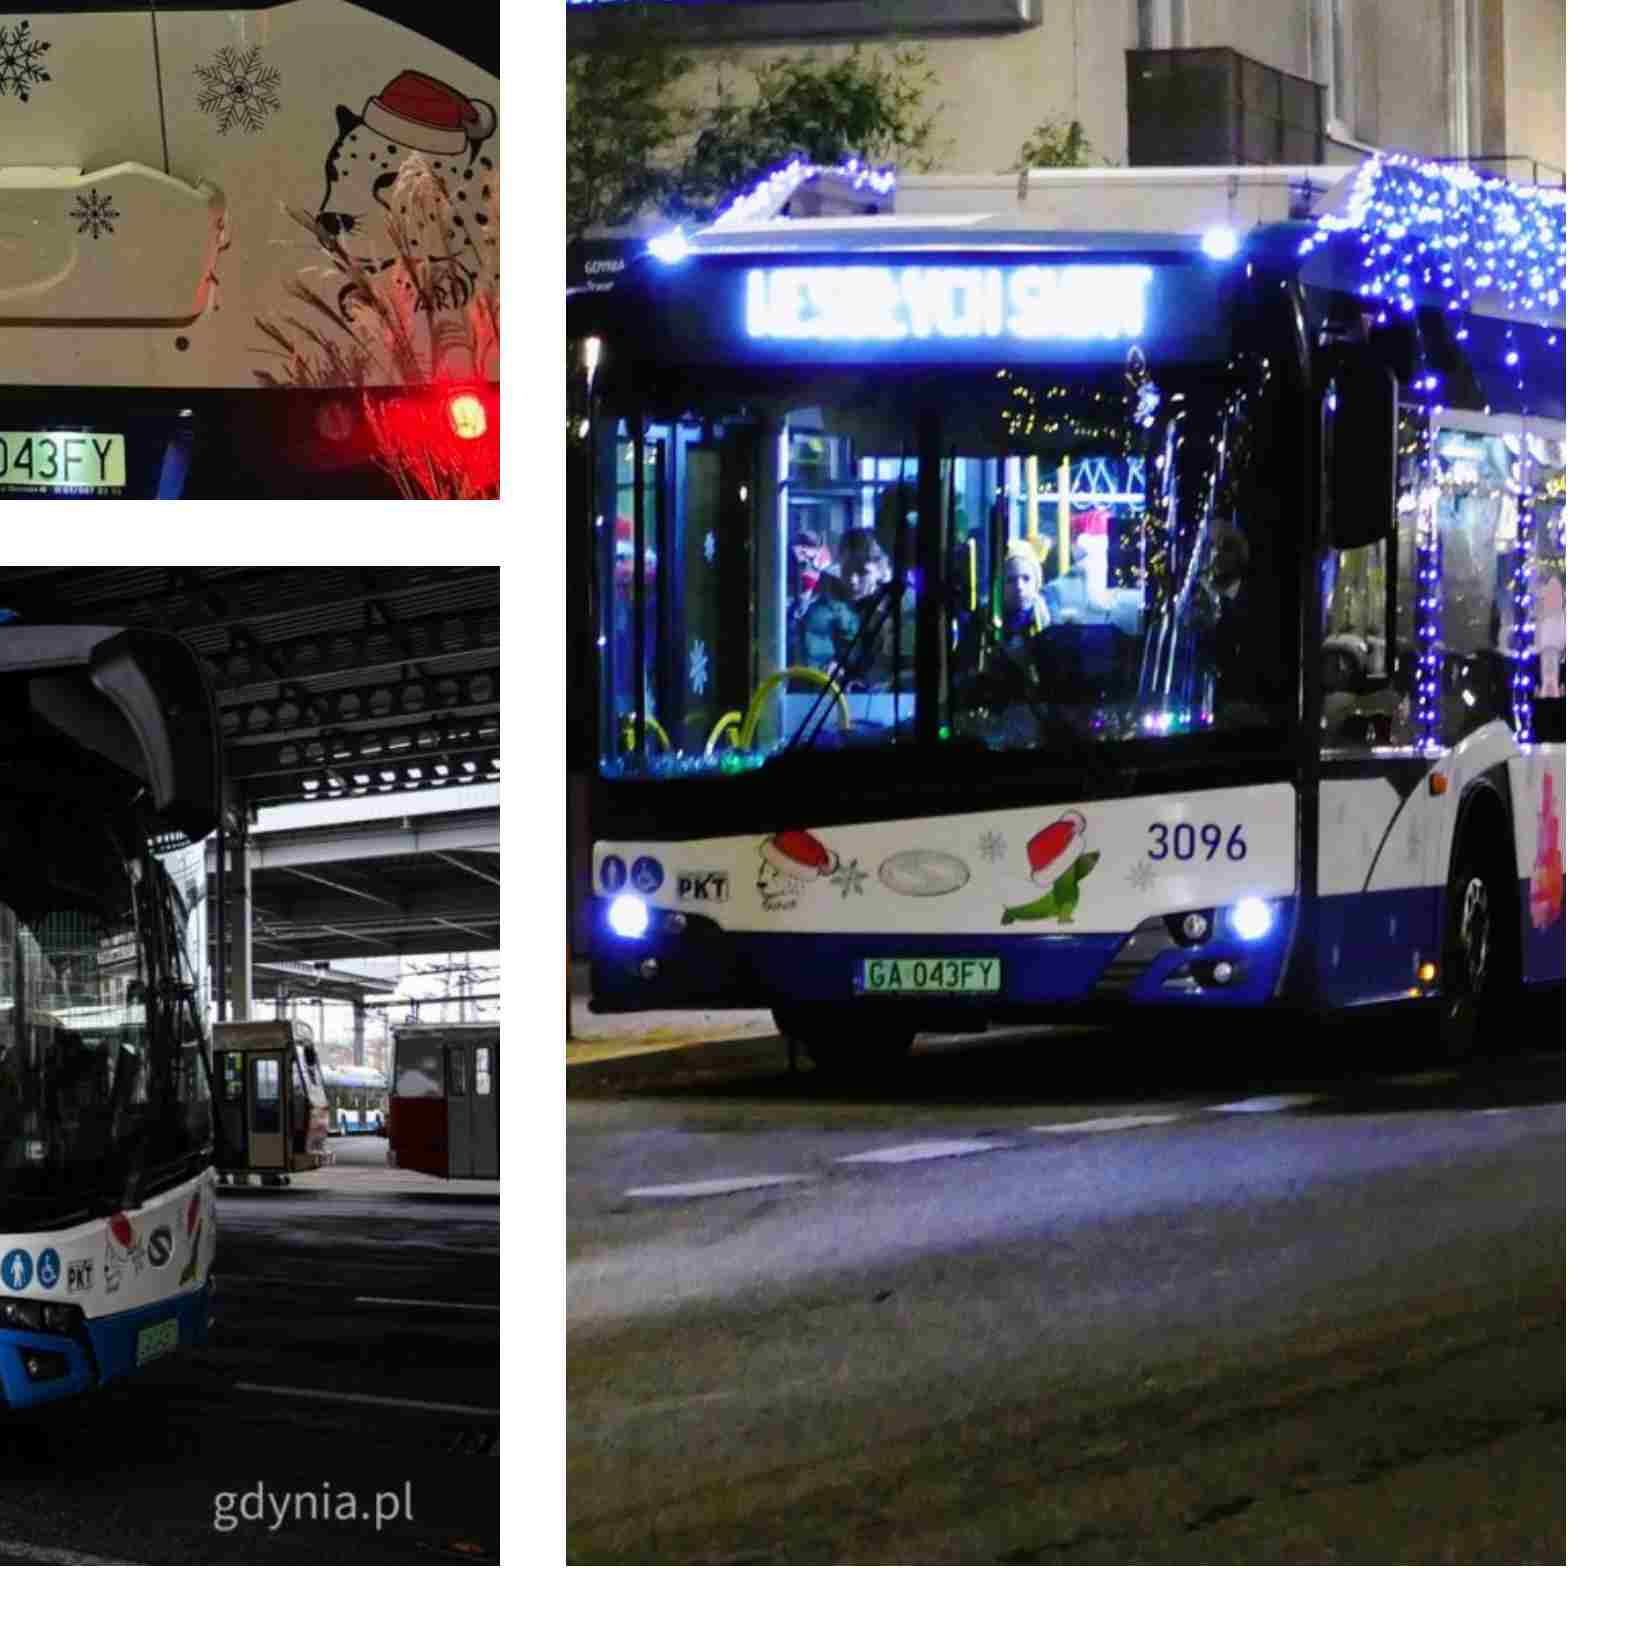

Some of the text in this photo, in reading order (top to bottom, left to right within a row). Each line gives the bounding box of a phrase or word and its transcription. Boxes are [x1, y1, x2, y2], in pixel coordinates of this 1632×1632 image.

[1147, 822, 1247, 861] 3096
[870, 961, 993, 988] GA 043FY
